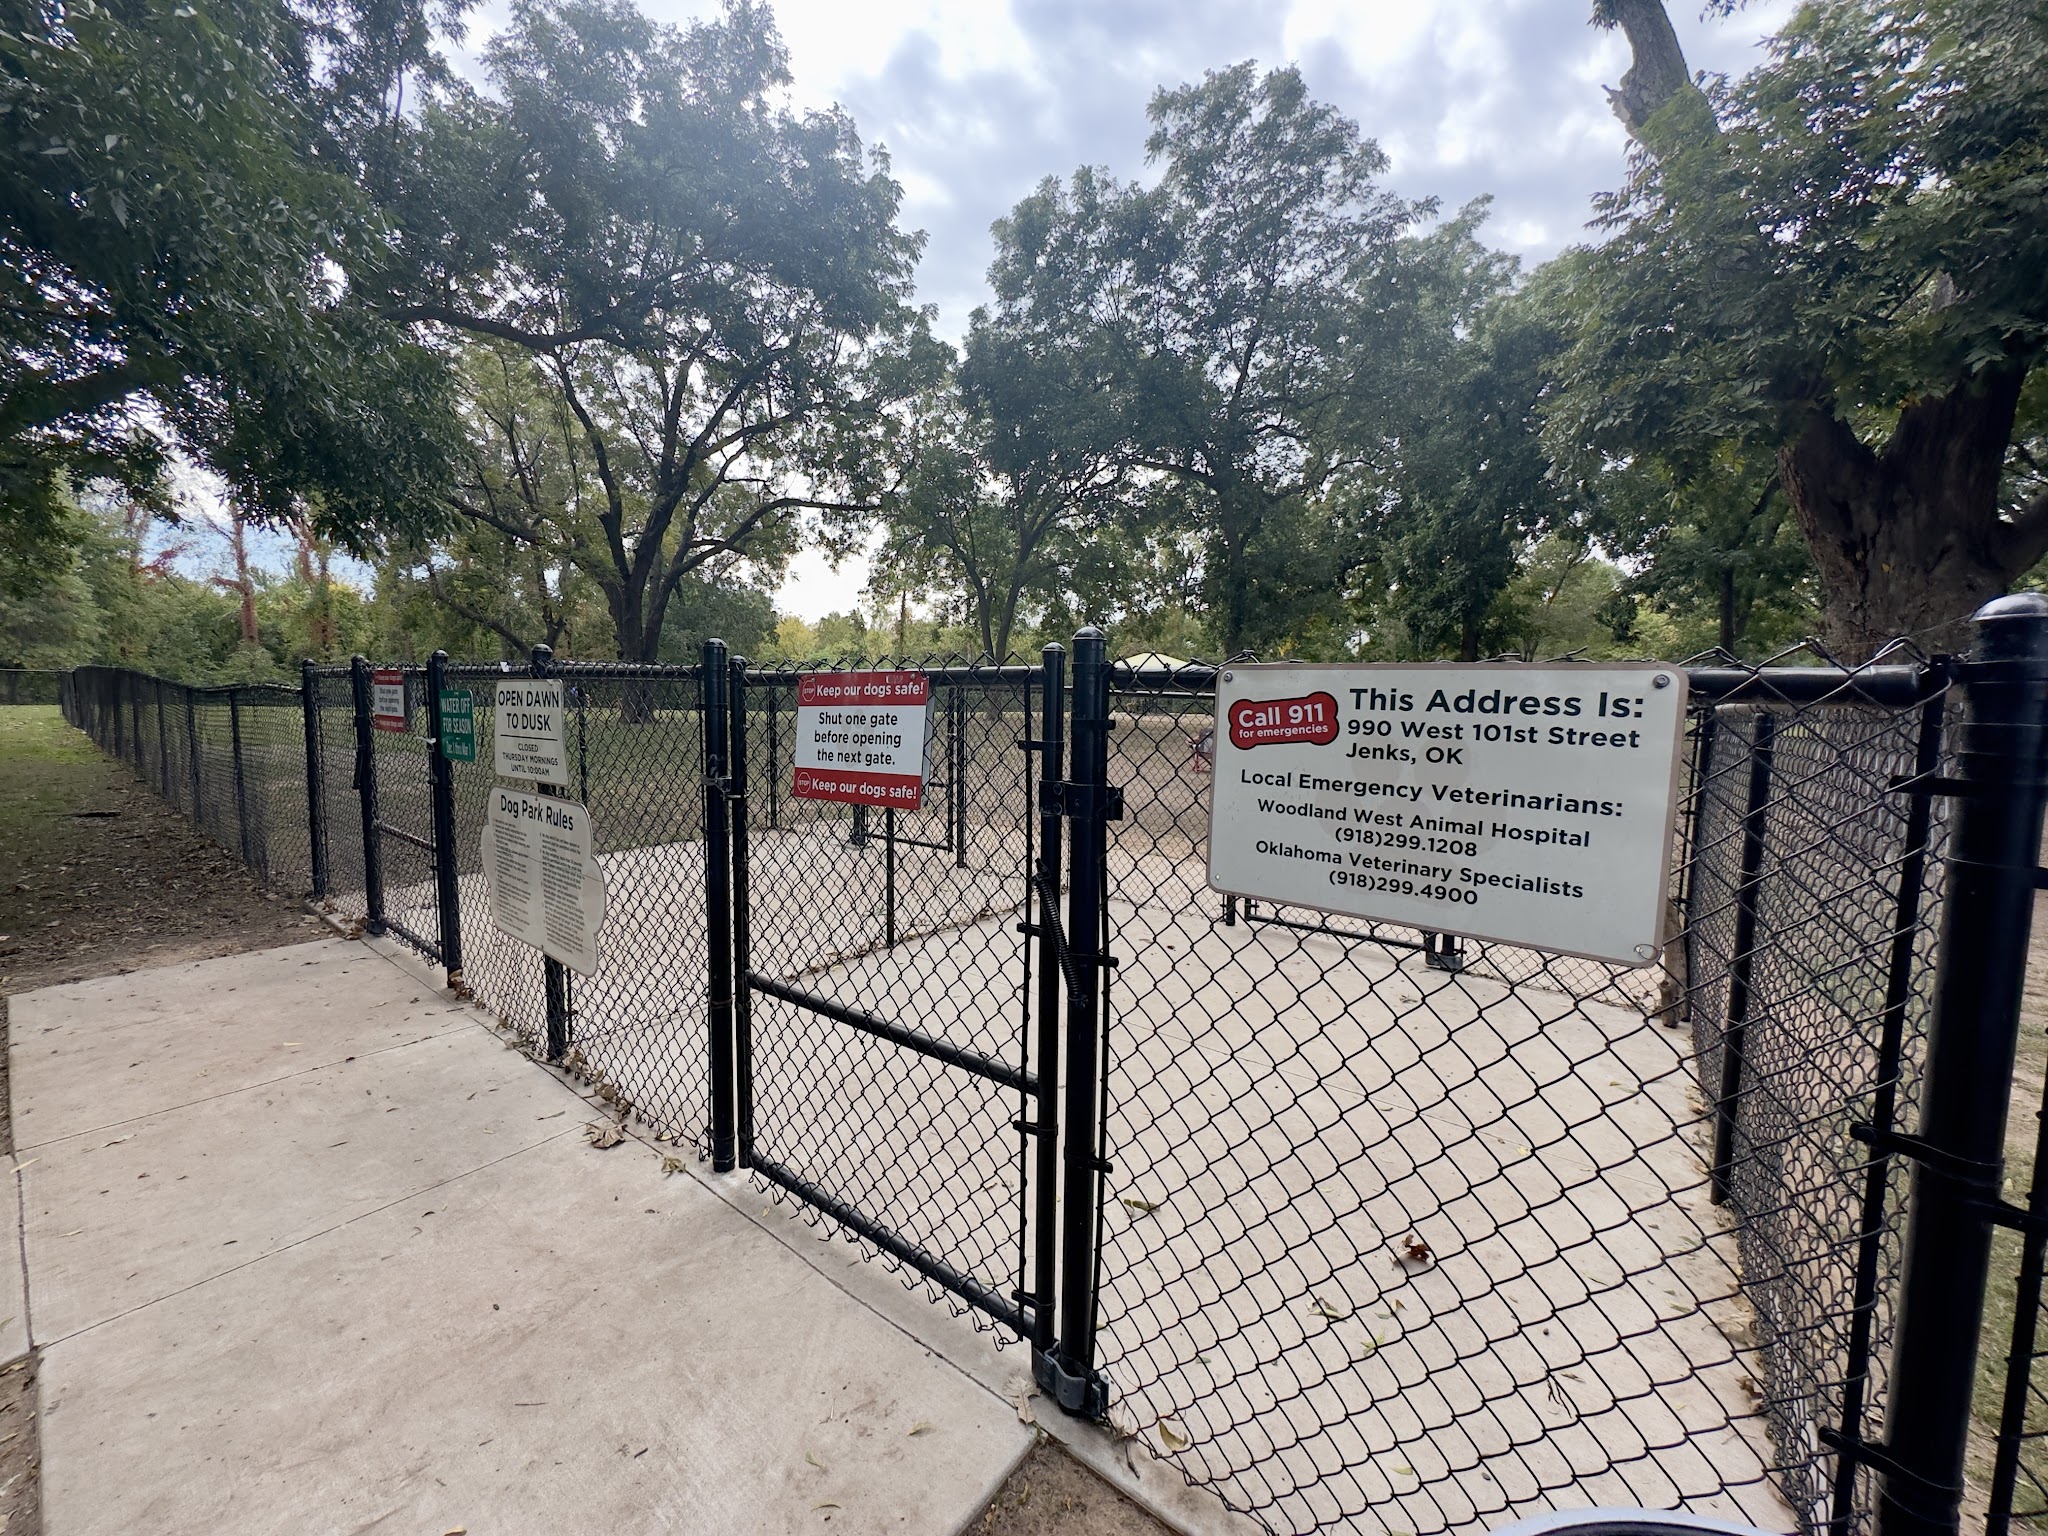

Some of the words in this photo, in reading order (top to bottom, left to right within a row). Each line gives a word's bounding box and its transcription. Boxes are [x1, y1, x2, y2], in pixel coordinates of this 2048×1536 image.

[498, 690, 523, 707] OPEN
[526, 690, 559, 708] DAWN
[817, 685, 841, 698] Keep
[843, 685, 861, 696] our
[863, 683, 892, 698] dogs
[894, 681, 924, 696] safe!
[441, 697, 460, 714] WATER
[460, 697, 470, 714] OFF
[1350, 688, 1414, 712] This
[1426, 689, 1582, 717] Address
[1598, 692, 1644, 718] Is:
[506, 713, 519, 729] TO
[521, 713, 551, 732] DUSK
[818, 711, 842, 725] Shut
[845, 714, 867, 725] one
[870, 712, 898, 728] gate
[1238, 706, 1281, 727] Call
[1288, 703, 1324, 724] 911
[442, 717, 453, 733] FOR
[453, 717, 472, 735] SEASON
[1239, 729, 1255, 738] for
[1257, 724, 1328, 737] emergencies
[1347, 719, 1392, 736] 990
[1400, 721, 1464, 740] West
[1472, 724, 1538, 743] 101st
[1548, 726, 1640, 748] Street
[518, 743, 538, 753] CLOSED
[814, 730, 849, 744] before
[852, 731, 902, 748] opening
[502, 752, 528, 762] THURSDAY
[529, 755, 559, 766] MORNINGS
[817, 748, 834, 762] the
[837, 750, 862, 763] next
[865, 752, 896, 766] gate.
[1345, 743, 1417, 765] Jenks,
[1425, 747, 1464, 765] OK
[510, 763, 526, 773] UNTIL
[812, 778, 837, 793] Keep
[839, 783, 857, 794] our
[859, 782, 887, 798] dogs
[889, 786, 917, 799] safe!
[1241, 769, 1292, 788] Local
[1299, 773, 1423, 802] Emergency
[1431, 784, 1623, 817] Veterinarians:
[500, 794, 519, 819] Dog
[521, 800, 543, 822] Park
[546, 806, 574, 831] Rules
[1257, 799, 1347, 821] Woodland
[1354, 808, 1403, 827] West
[1409, 815, 1483, 836] Animal
[1491, 822, 1590, 847] Hospital
[1335, 827, 1477, 857] (918)299.1208
[1256, 840, 1342, 864] Oklahoma
[1349, 852, 1453, 882] Veterinary
[1459, 867, 1584, 898] Specialists
[1329, 870, 1478, 905] (918)299.4900
